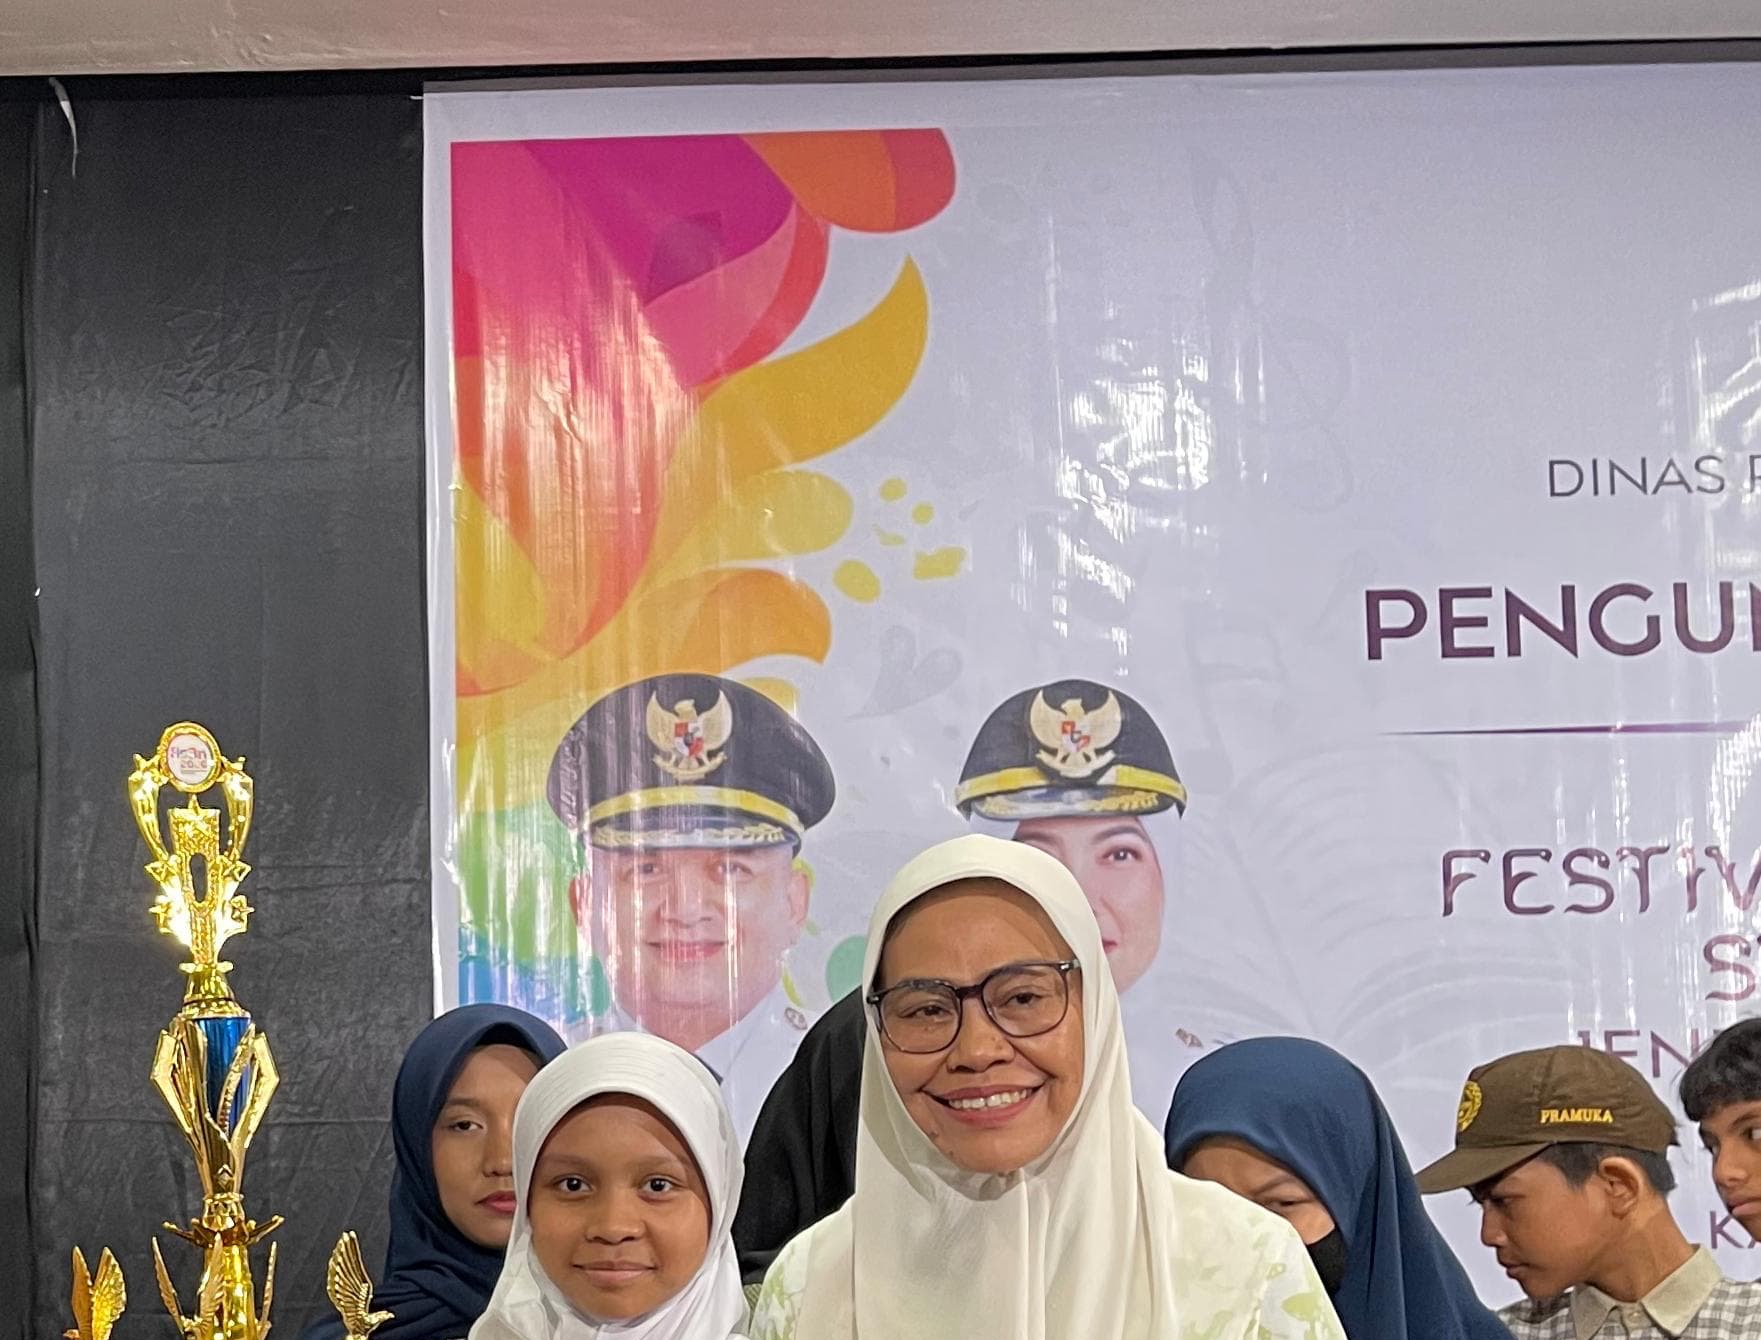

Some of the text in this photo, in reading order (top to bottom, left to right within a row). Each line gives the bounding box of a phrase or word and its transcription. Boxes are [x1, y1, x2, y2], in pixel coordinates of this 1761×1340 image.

[1548, 454, 1726, 498] DINAS
[1365, 580, 1761, 660] PENGU
[1441, 845, 1761, 917] FESTIV
[1702, 934, 1761, 1001] S
[1540, 1108, 1614, 1124] PRAMUKA
[1709, 1210, 1756, 1250] K
